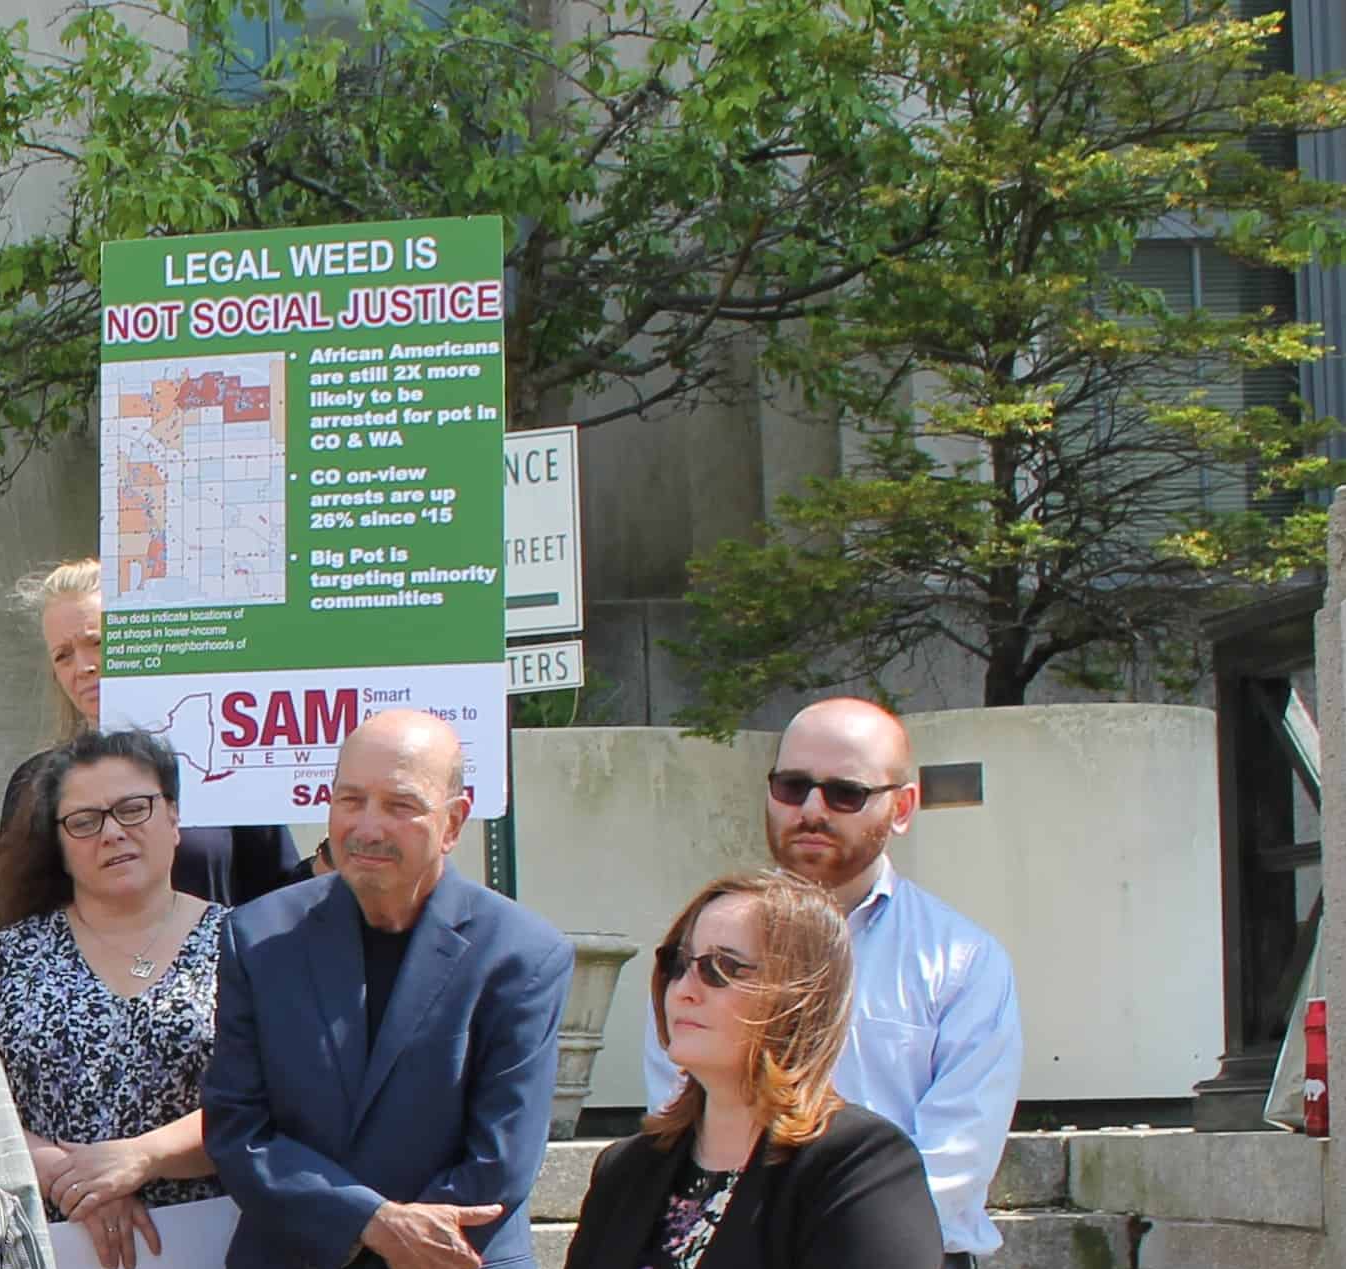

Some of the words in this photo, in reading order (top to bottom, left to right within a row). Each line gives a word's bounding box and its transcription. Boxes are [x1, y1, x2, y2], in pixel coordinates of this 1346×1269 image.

[165, 248, 280, 287] LEGAL
[289, 240, 394, 277] WEED
[405, 237, 438, 270] IS
[107, 303, 181, 341] NOT
[193, 295, 330, 336] SOCIAL
[342, 284, 500, 326] JUSTICE
[309, 347, 384, 364] African
[389, 341, 499, 360] Americans
[310, 373, 344, 386] are
[349, 366, 388, 383] still
[393, 364, 421, 381] 2X
[427, 365, 481, 379] more
[310, 390, 365, 408] likely
[370, 389, 392, 404] to
[397, 387, 423, 402] be
[310, 410, 397, 428] arrested
[403, 407, 432, 425] for
[437, 406, 472, 425] pot
[477, 404, 497, 420] in
[310, 433, 341, 450] CO
[347, 433, 362, 449] &
[369, 431, 404, 448] WA
[310, 469, 341, 486] CO
[346, 465, 427, 484] on-view
[505, 449, 559, 486] NCE
[310, 489, 384, 507] arrests
[389, 489, 425, 504] are
[430, 488, 456, 505] up
[310, 511, 354, 529] 26%
[360, 509, 416, 527] since
[311, 550, 344, 568] Big
[350, 548, 384, 564] Pot
[389, 546, 408, 562] is
[505, 534, 567, 565] TREET
[310, 570, 405, 590] targeting
[411, 566, 497, 584] minority
[310, 589, 444, 610] communities
[107, 614, 128, 625] Blue
[129, 614, 150, 624] dots
[152, 611, 189, 623] indicate
[190, 609, 232, 622] locations
[234, 608, 245, 619] of
[106, 629, 122, 642] pot
[124, 628, 152, 641] shops
[153, 627, 163, 638] in
[164, 625, 227, 638] lower-income
[106, 643, 125, 656] and
[126, 642, 164, 656] minority
[165, 639, 234, 654] neighborhoods
[236, 638, 247, 649] of
[144, 657, 161, 669] CO
[508, 651, 568, 685] TERS
[221, 688, 358, 748] SAM
[363, 687, 411, 703] Smart
[462, 705, 477, 720] to
[232, 752, 311, 765] NEW
